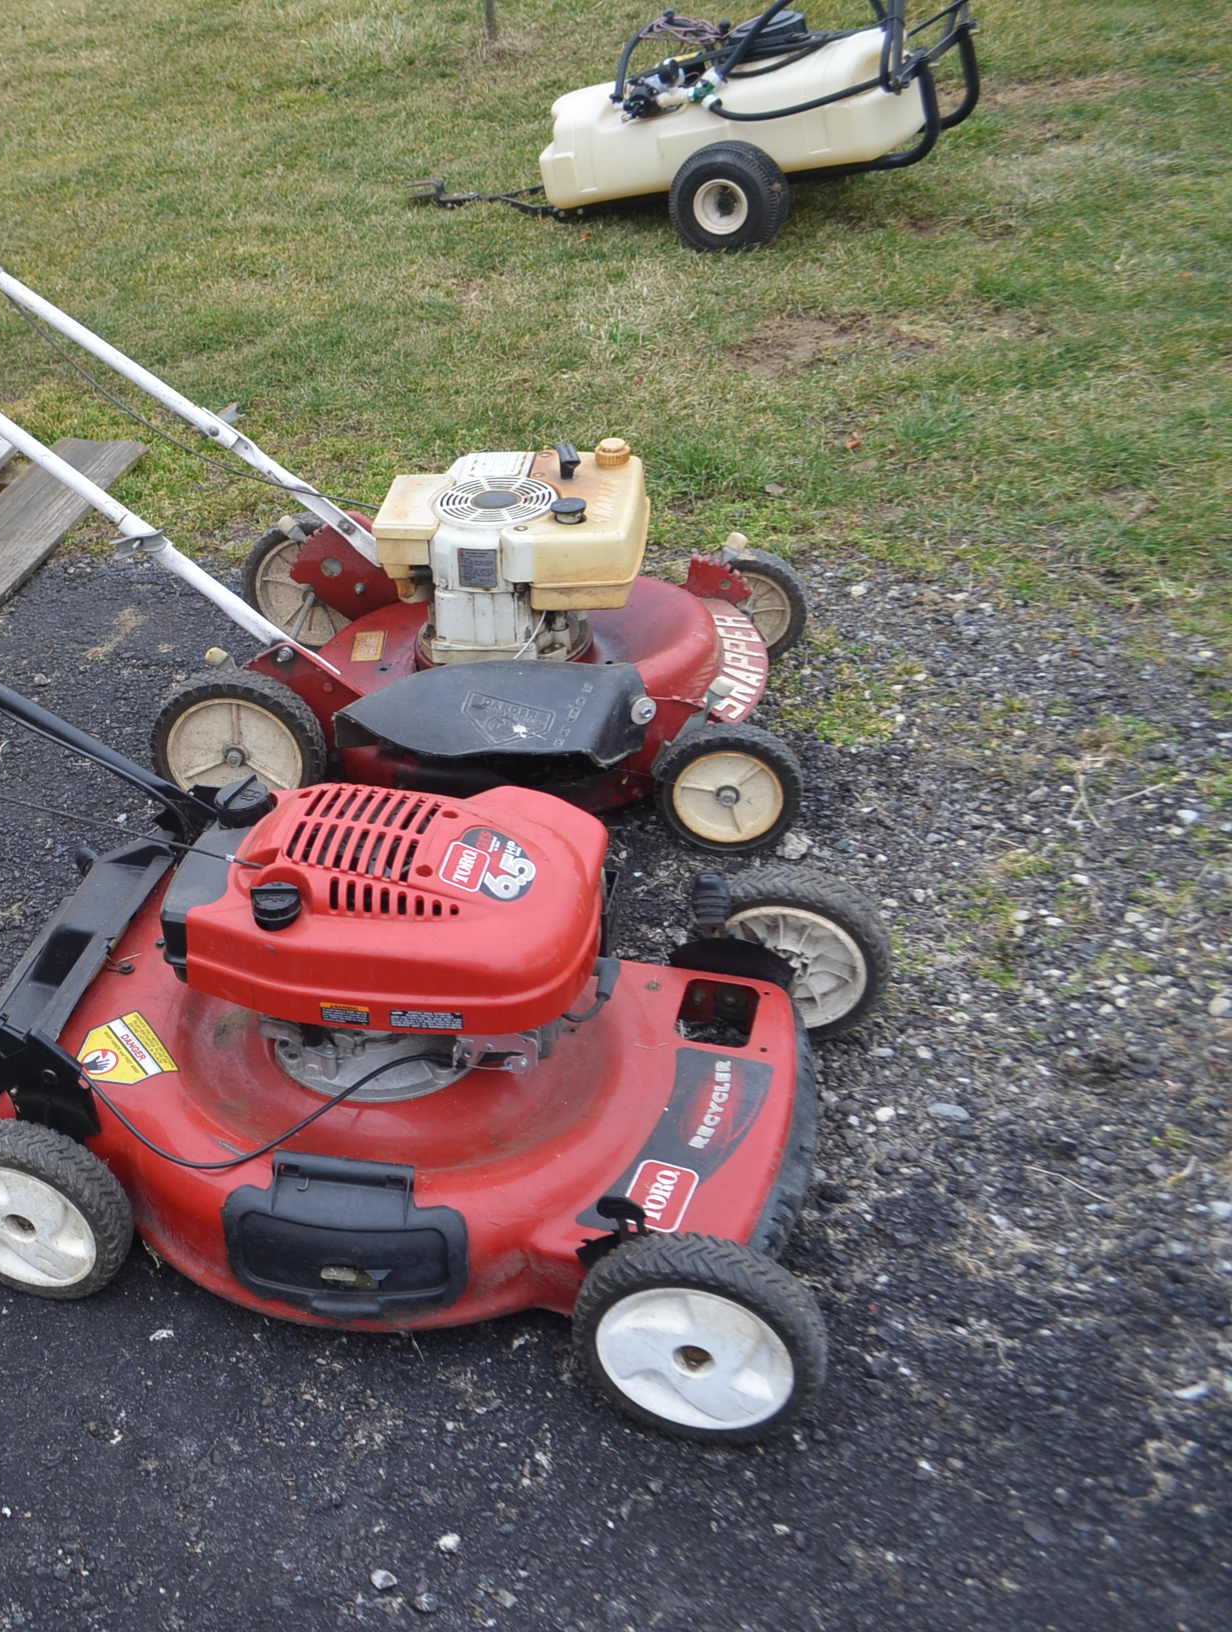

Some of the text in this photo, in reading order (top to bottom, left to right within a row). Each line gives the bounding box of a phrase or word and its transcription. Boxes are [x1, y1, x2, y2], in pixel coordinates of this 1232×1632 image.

[711, 614, 765, 720] SNAPPER
[452, 849, 478, 883] TORO
[120, 1033, 147, 1061] DANGER
[687, 1060, 732, 1150] RECYCLER
[642, 1169, 680, 1221] TORO
